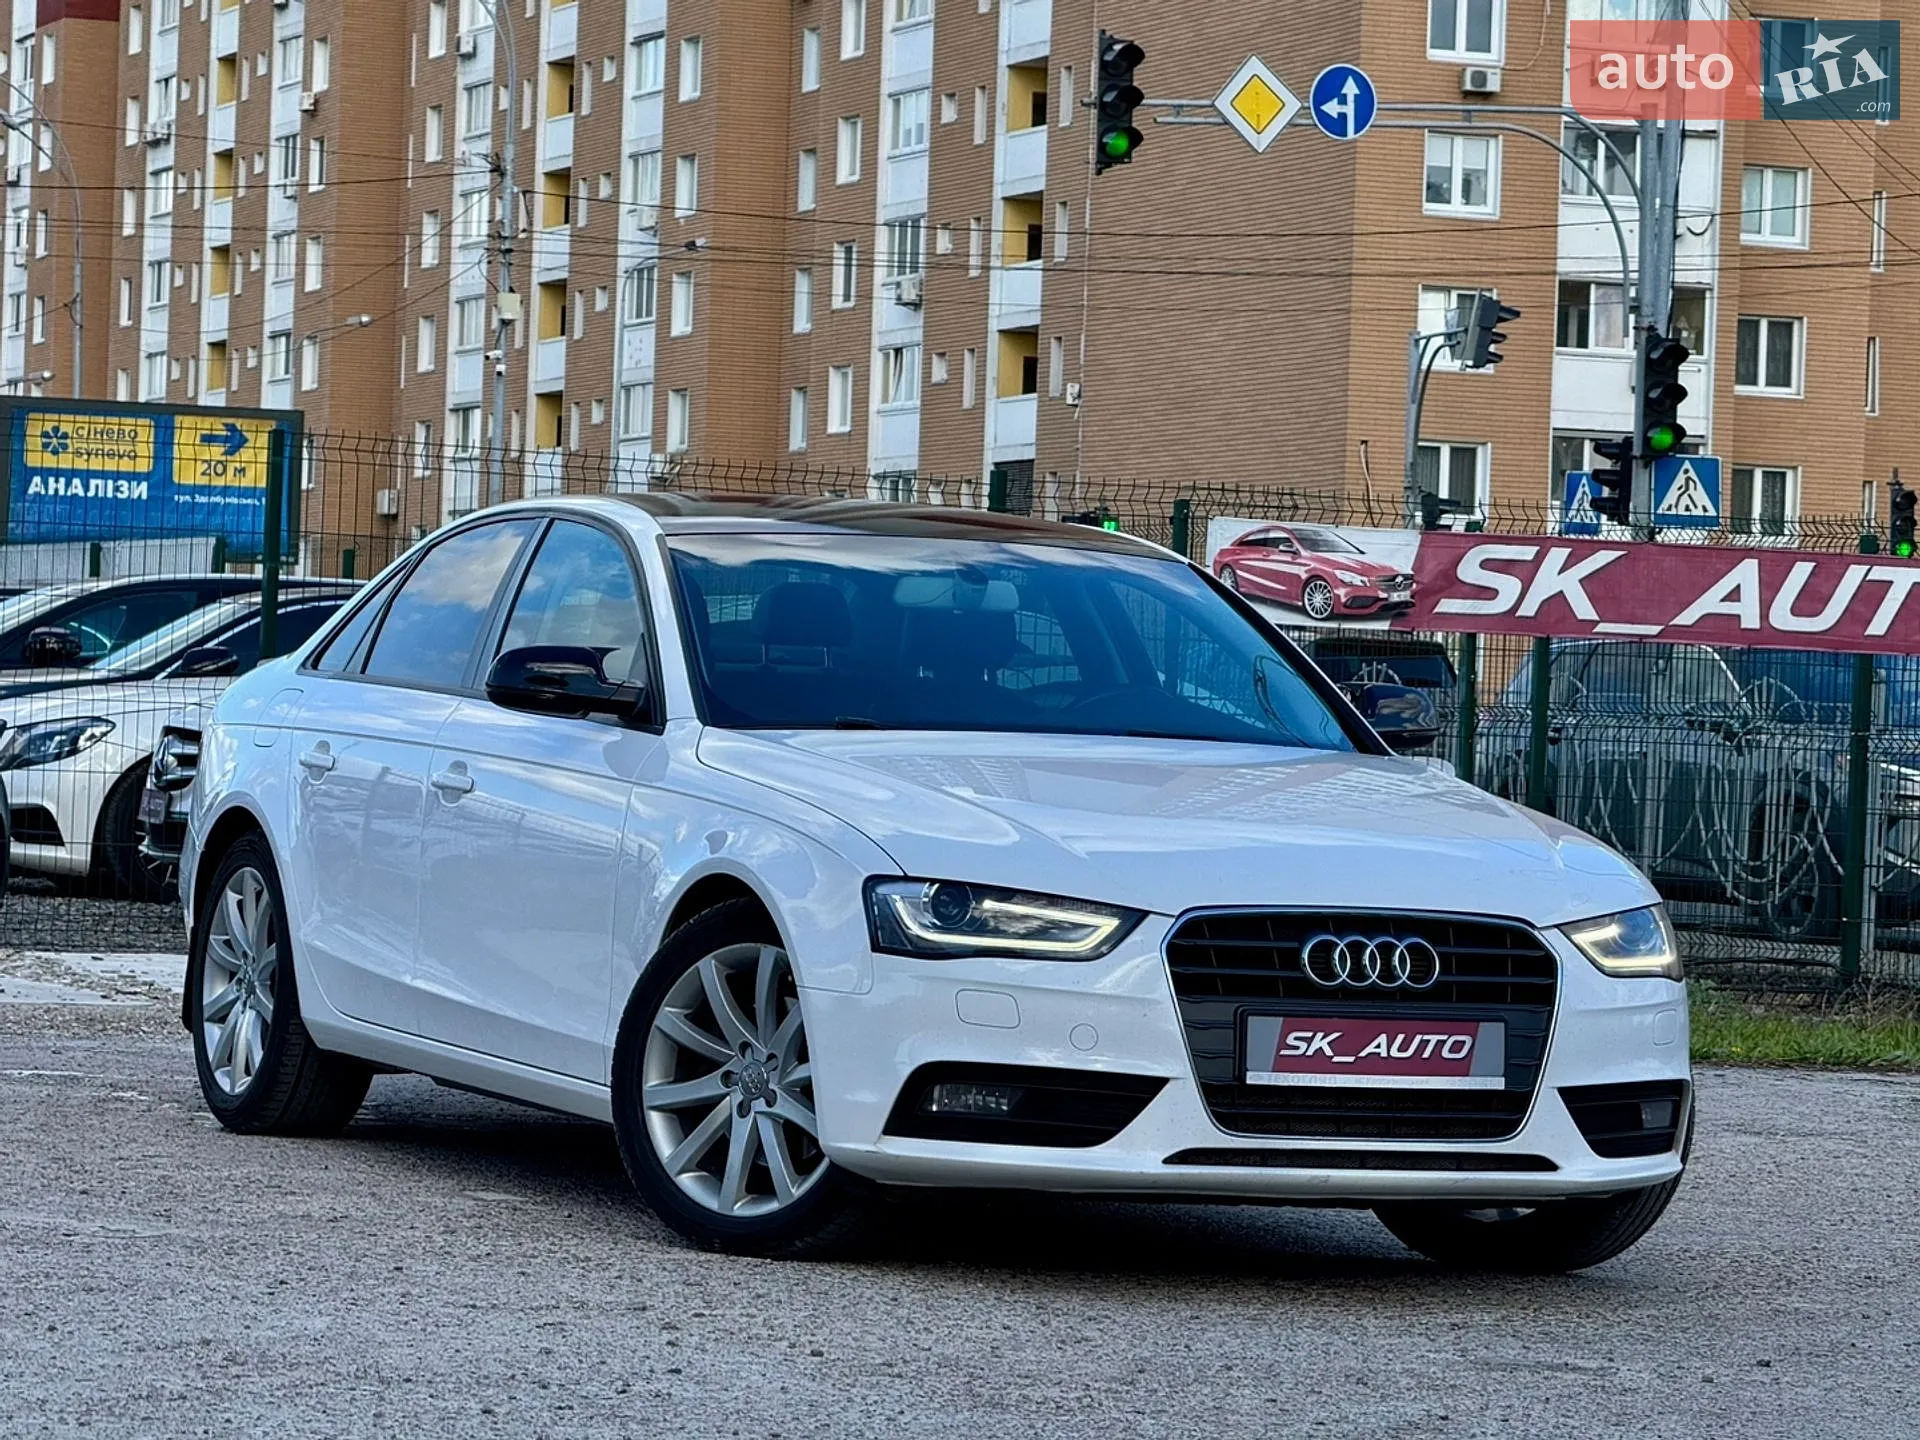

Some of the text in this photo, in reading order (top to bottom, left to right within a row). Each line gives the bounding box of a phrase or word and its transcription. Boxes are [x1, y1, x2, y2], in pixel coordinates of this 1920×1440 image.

[200, 460, 227, 477] 20
[27, 475, 149, 500] АНАЛІЗИ
[1279, 1031, 1474, 1063] SK_AUTO
